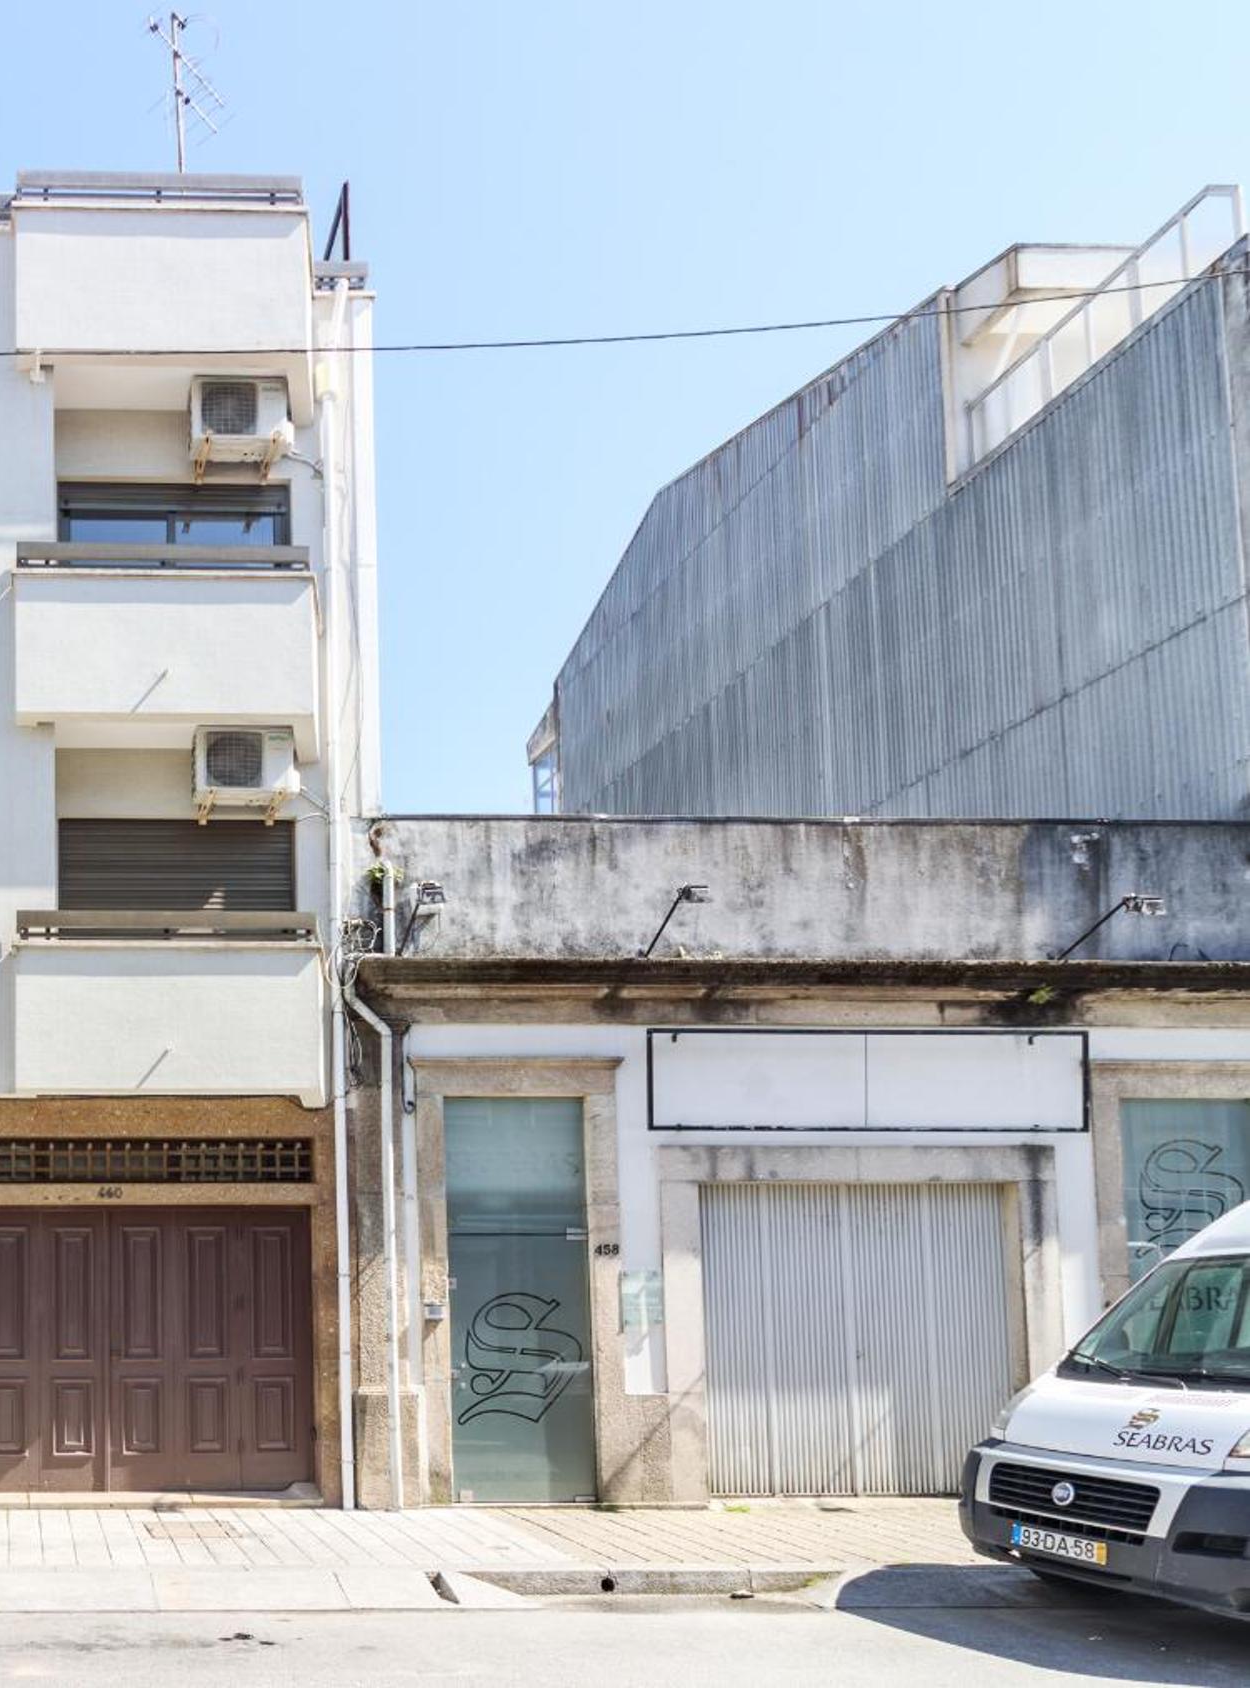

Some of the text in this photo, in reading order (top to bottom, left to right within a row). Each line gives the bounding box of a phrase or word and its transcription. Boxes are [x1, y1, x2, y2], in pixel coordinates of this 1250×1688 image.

[594, 1244, 620, 1256] 458
[1113, 1431, 1214, 1456] SEABRAS
[1022, 1529, 1094, 1560] 93-DA-58
